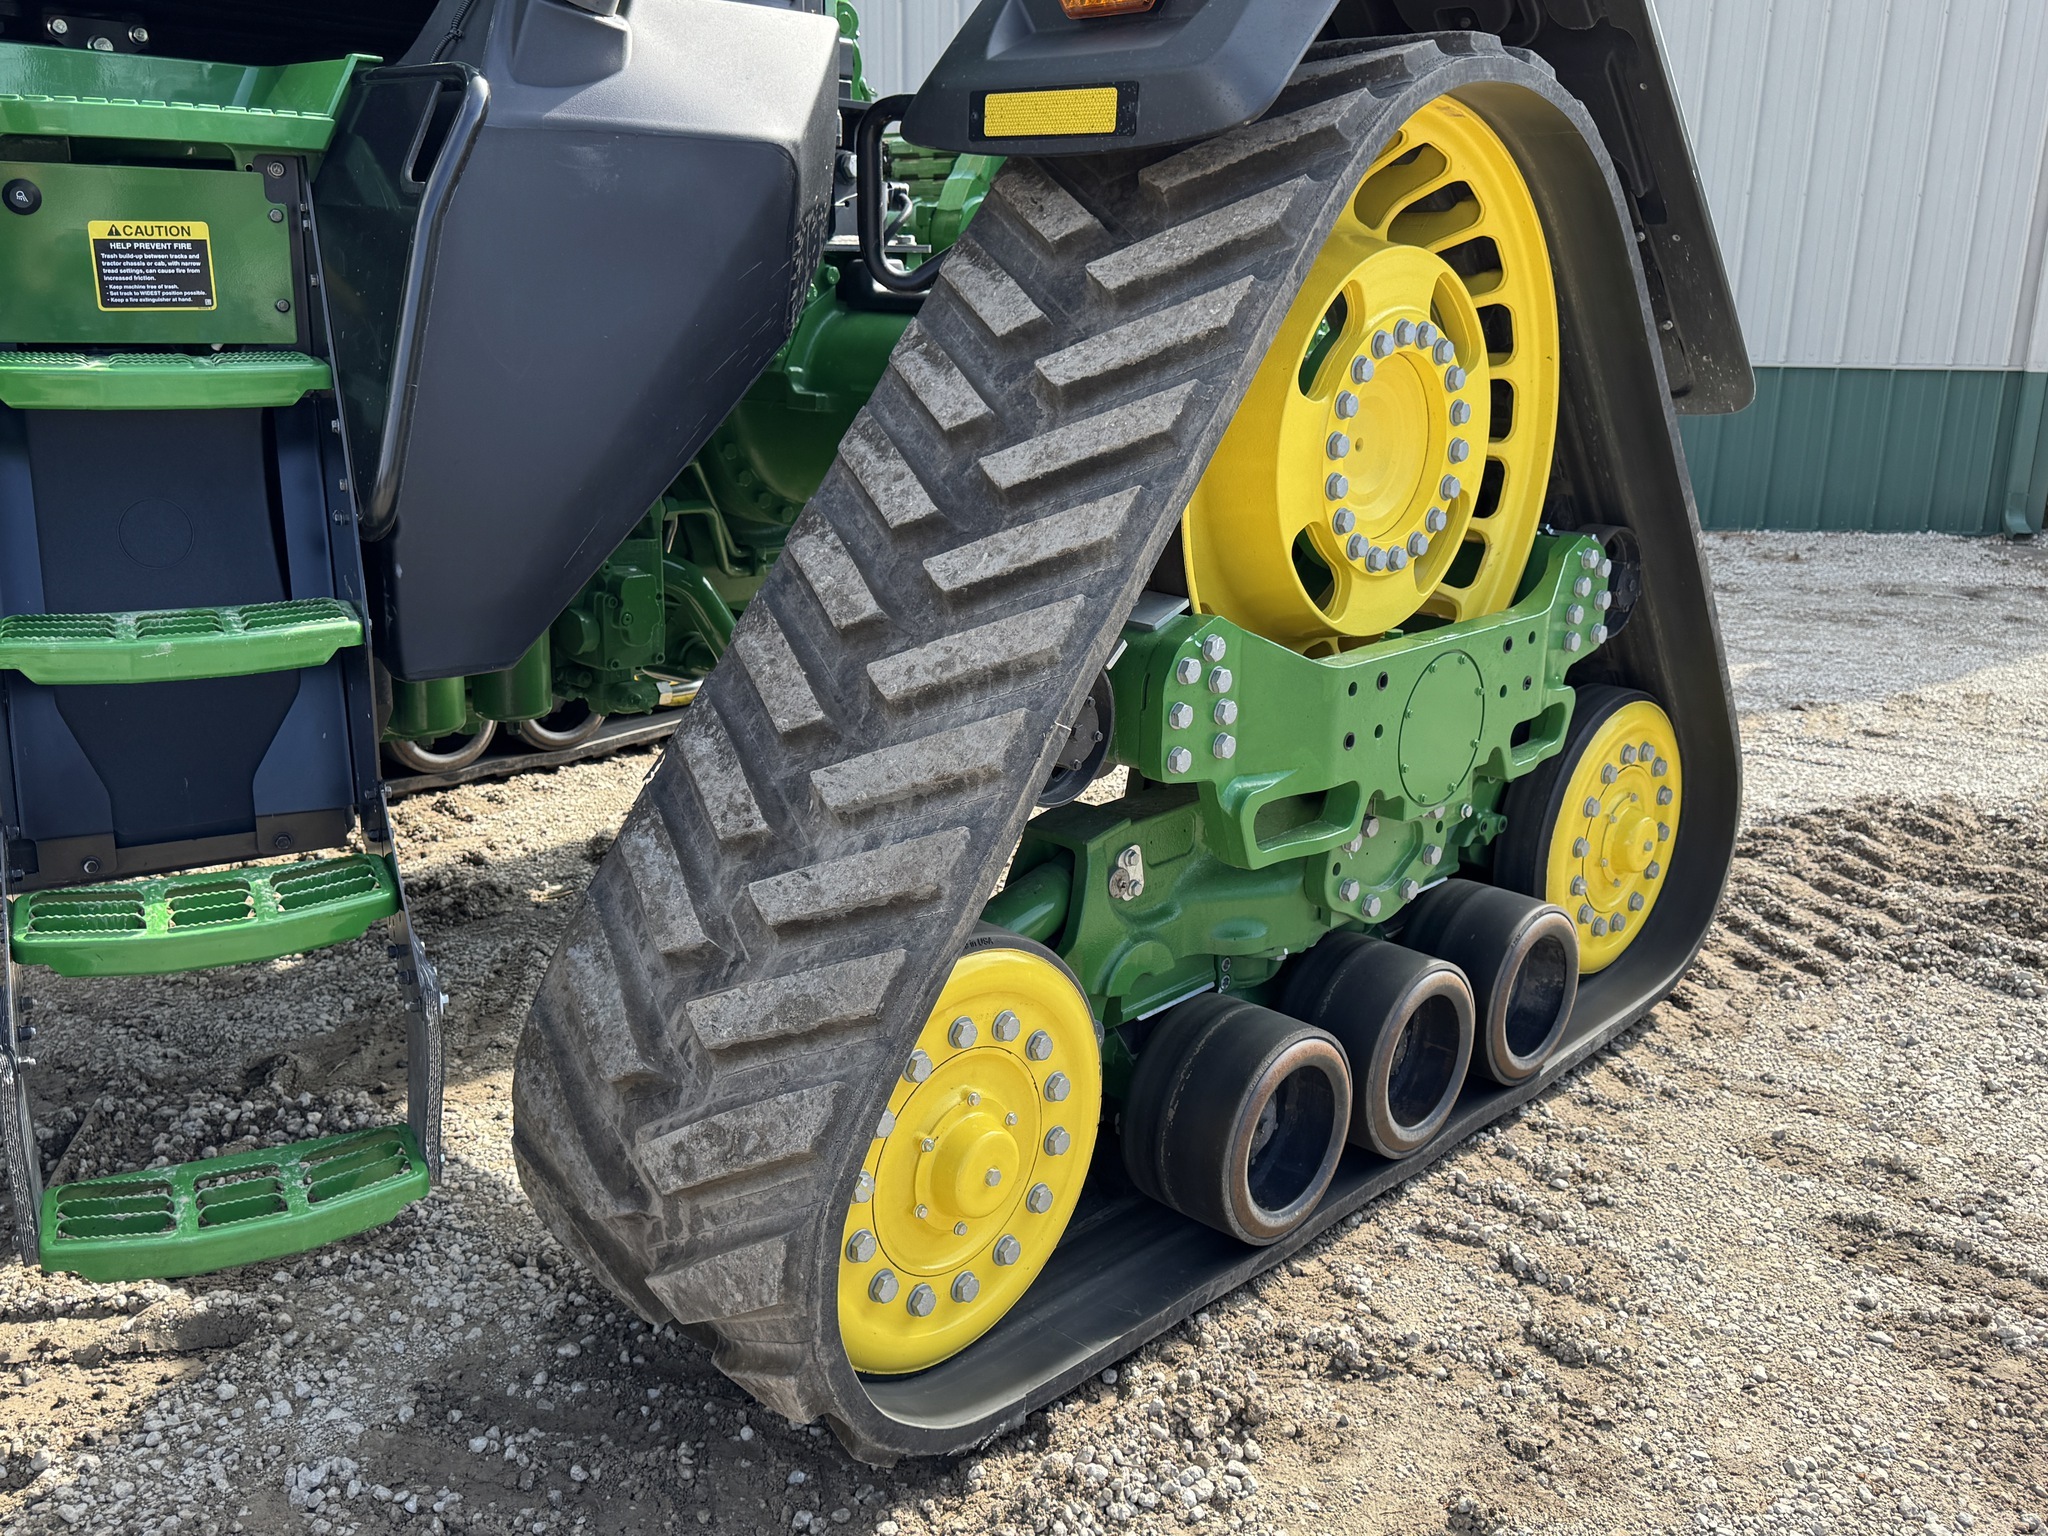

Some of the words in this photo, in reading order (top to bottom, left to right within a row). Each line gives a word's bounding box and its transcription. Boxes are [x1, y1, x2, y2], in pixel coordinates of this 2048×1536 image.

[122, 225, 191, 237] CAUTION
[109, 242, 131, 250] HELP
[134, 242, 172, 250] PREVENT
[173, 242, 192, 250] FIRE
[977, 937, 994, 946] USA
